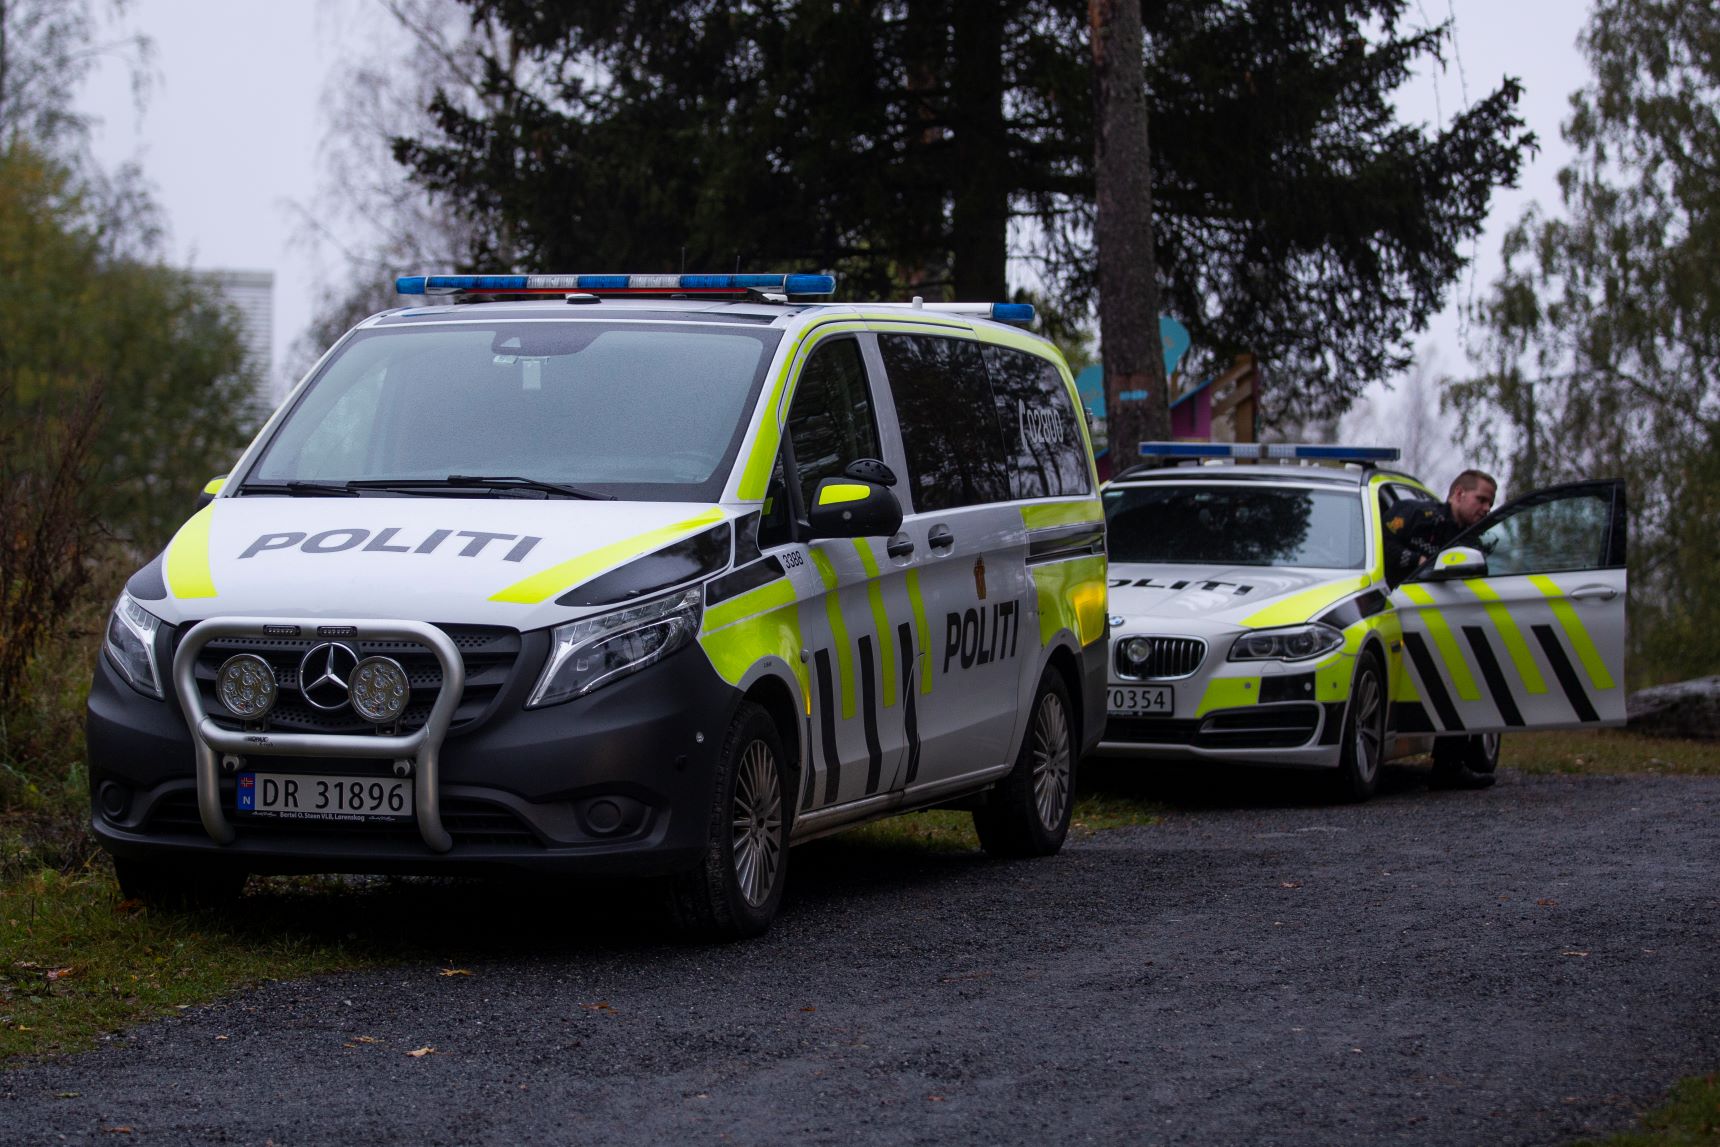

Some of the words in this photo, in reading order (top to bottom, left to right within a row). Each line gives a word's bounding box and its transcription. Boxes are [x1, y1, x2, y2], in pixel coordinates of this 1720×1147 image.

[1026, 409, 1064, 443] 02800
[237, 527, 544, 563] POLITI
[782, 550, 804, 569] 3388
[1108, 578, 1254, 596] OLITI
[943, 599, 1020, 674] POLITI
[242, 796, 251, 805] N
[262, 778, 299, 808] DR
[315, 780, 404, 812] 31896
